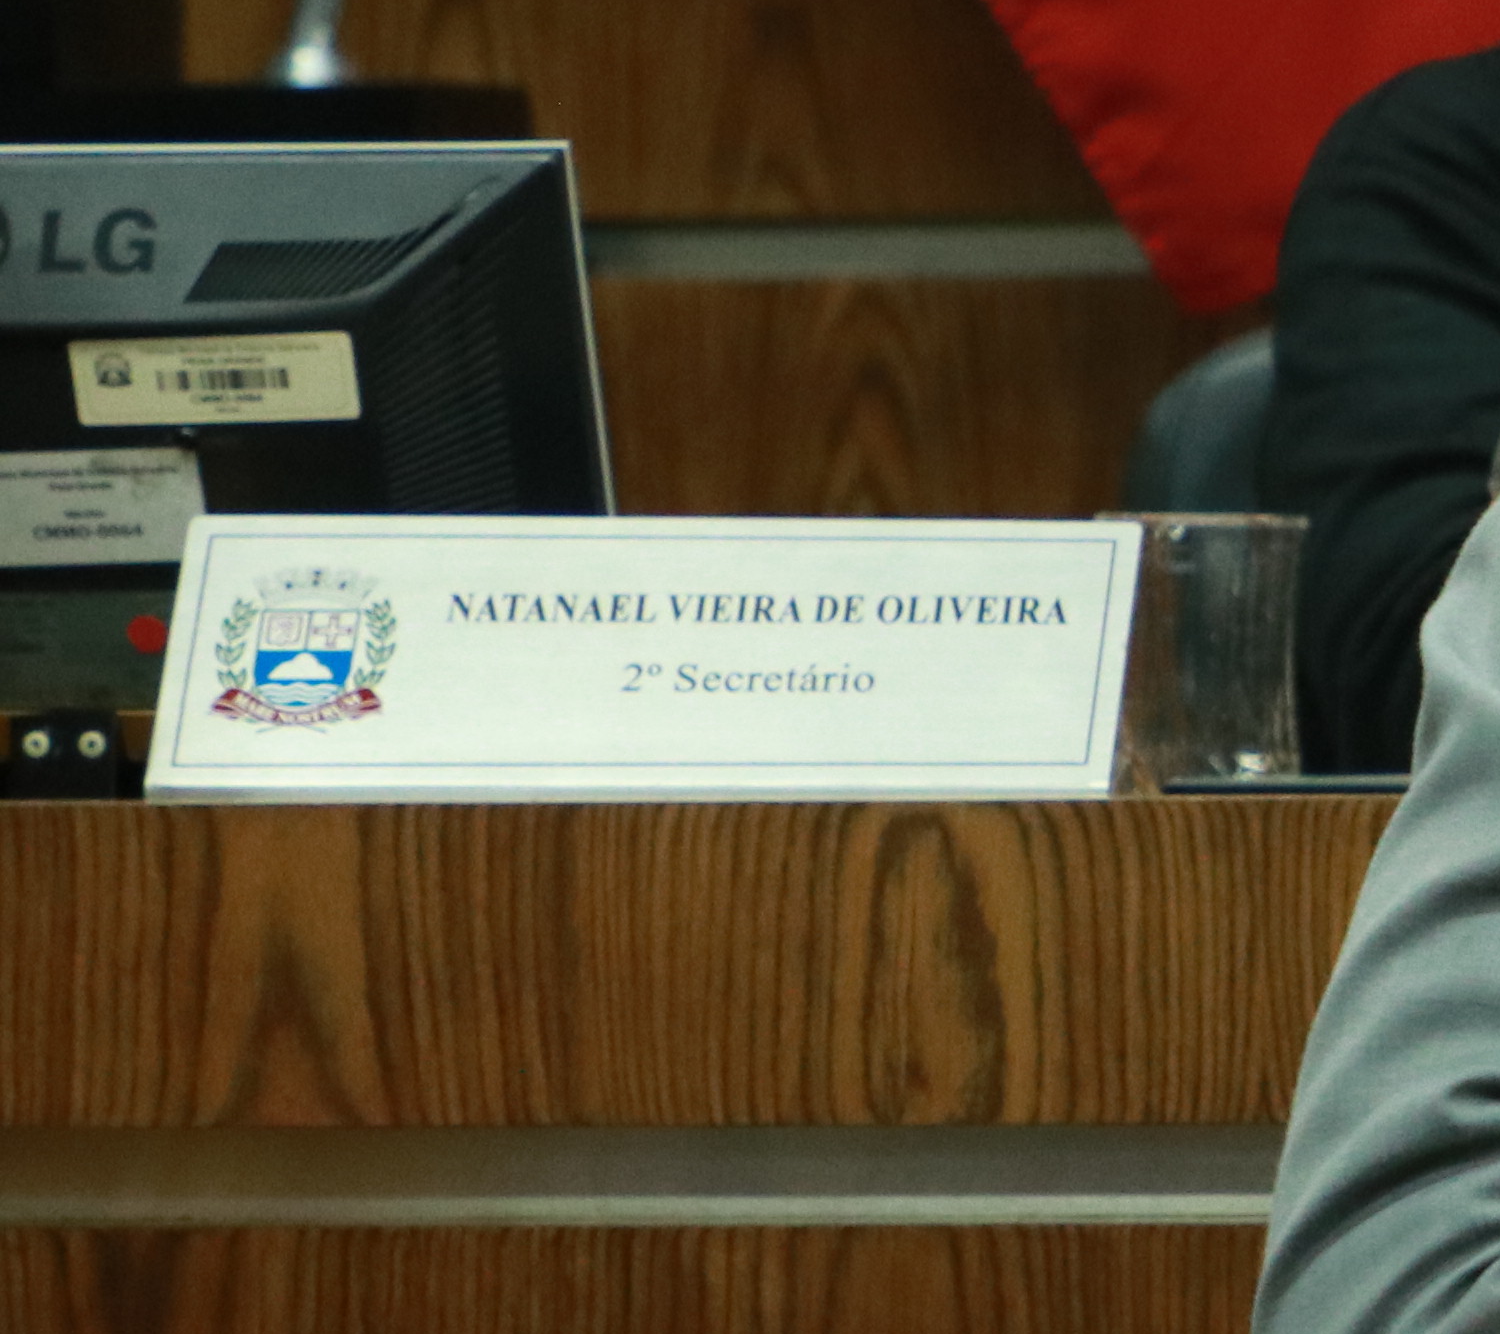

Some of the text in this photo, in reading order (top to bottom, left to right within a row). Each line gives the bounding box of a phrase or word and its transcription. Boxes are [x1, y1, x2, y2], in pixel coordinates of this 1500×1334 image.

[39, 208, 156, 274] LG
[448, 593, 1067, 625] NATANAEL VIEIRA DE OLIVEIRA
[674, 662, 875, 693] Secretário
